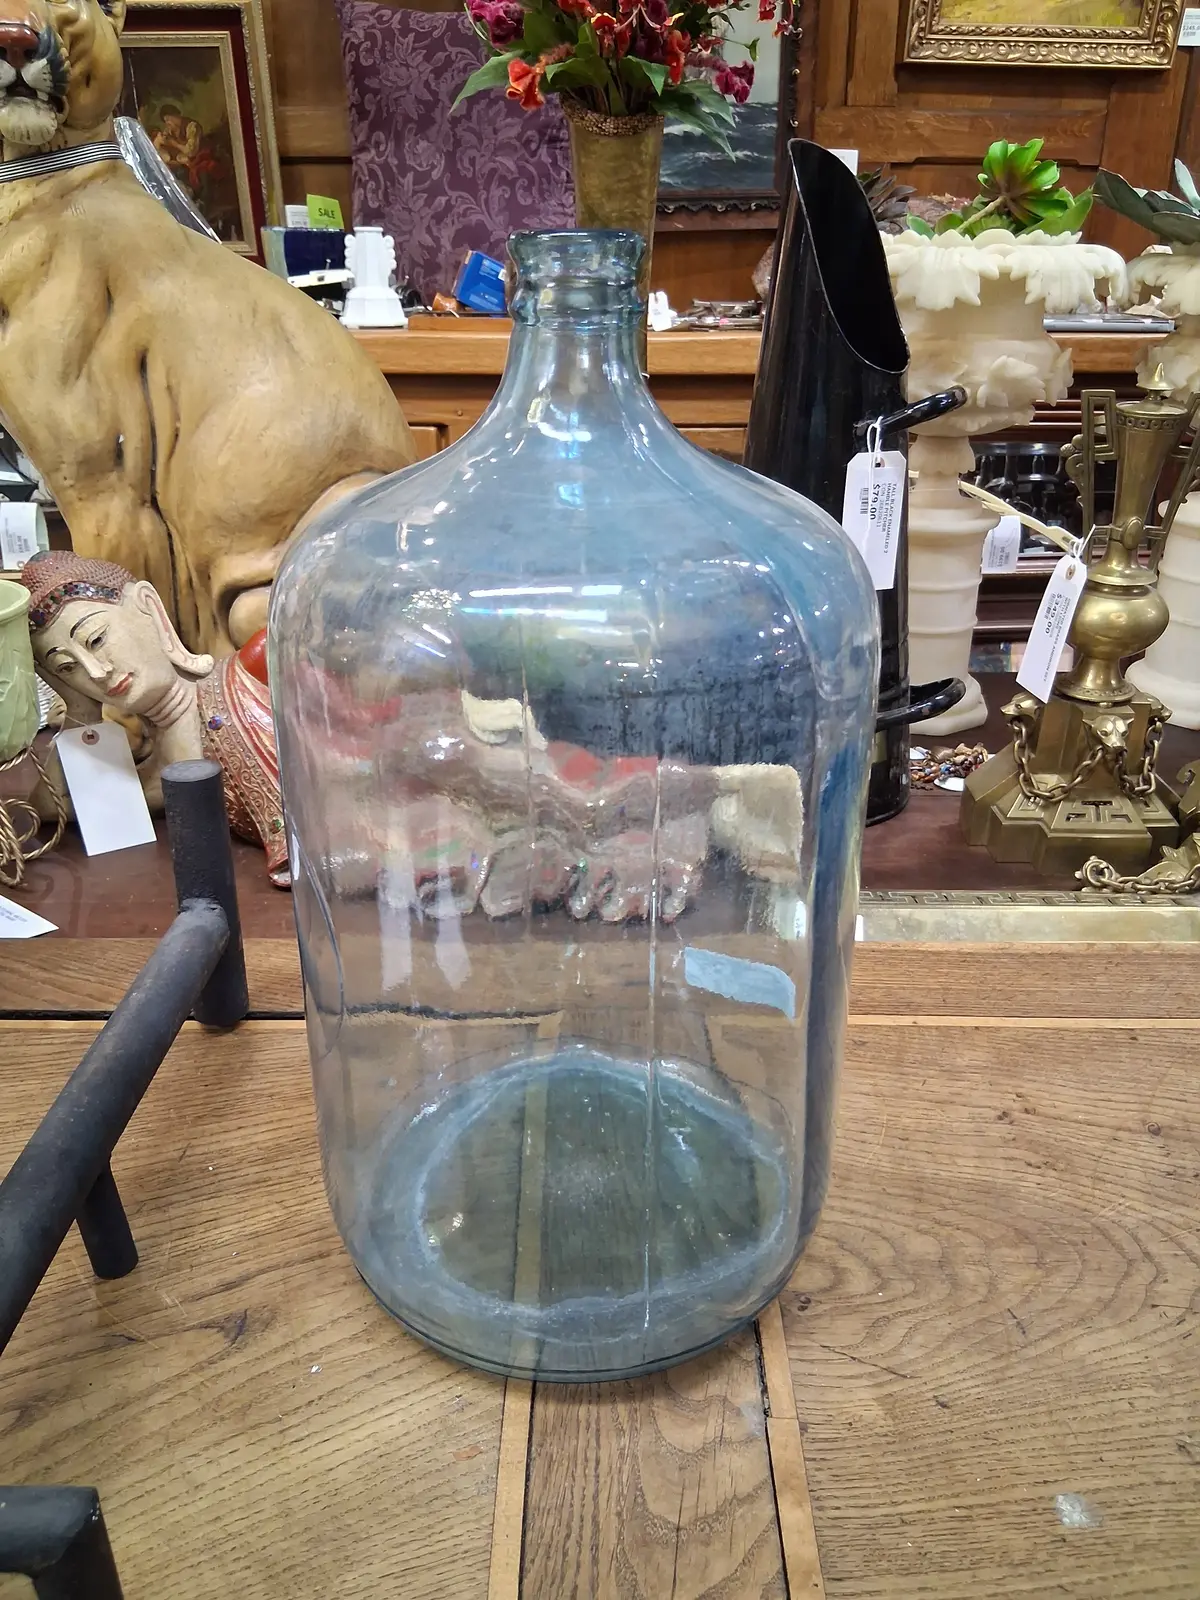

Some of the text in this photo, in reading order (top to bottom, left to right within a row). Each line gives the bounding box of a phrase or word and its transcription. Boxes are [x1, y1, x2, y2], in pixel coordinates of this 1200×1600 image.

[318, 207, 335, 219] SALE
[869, 483, 881, 520] $79.00
[884, 518, 892, 549] ENAMELED
[1045, 593, 1062, 634] $349.00
